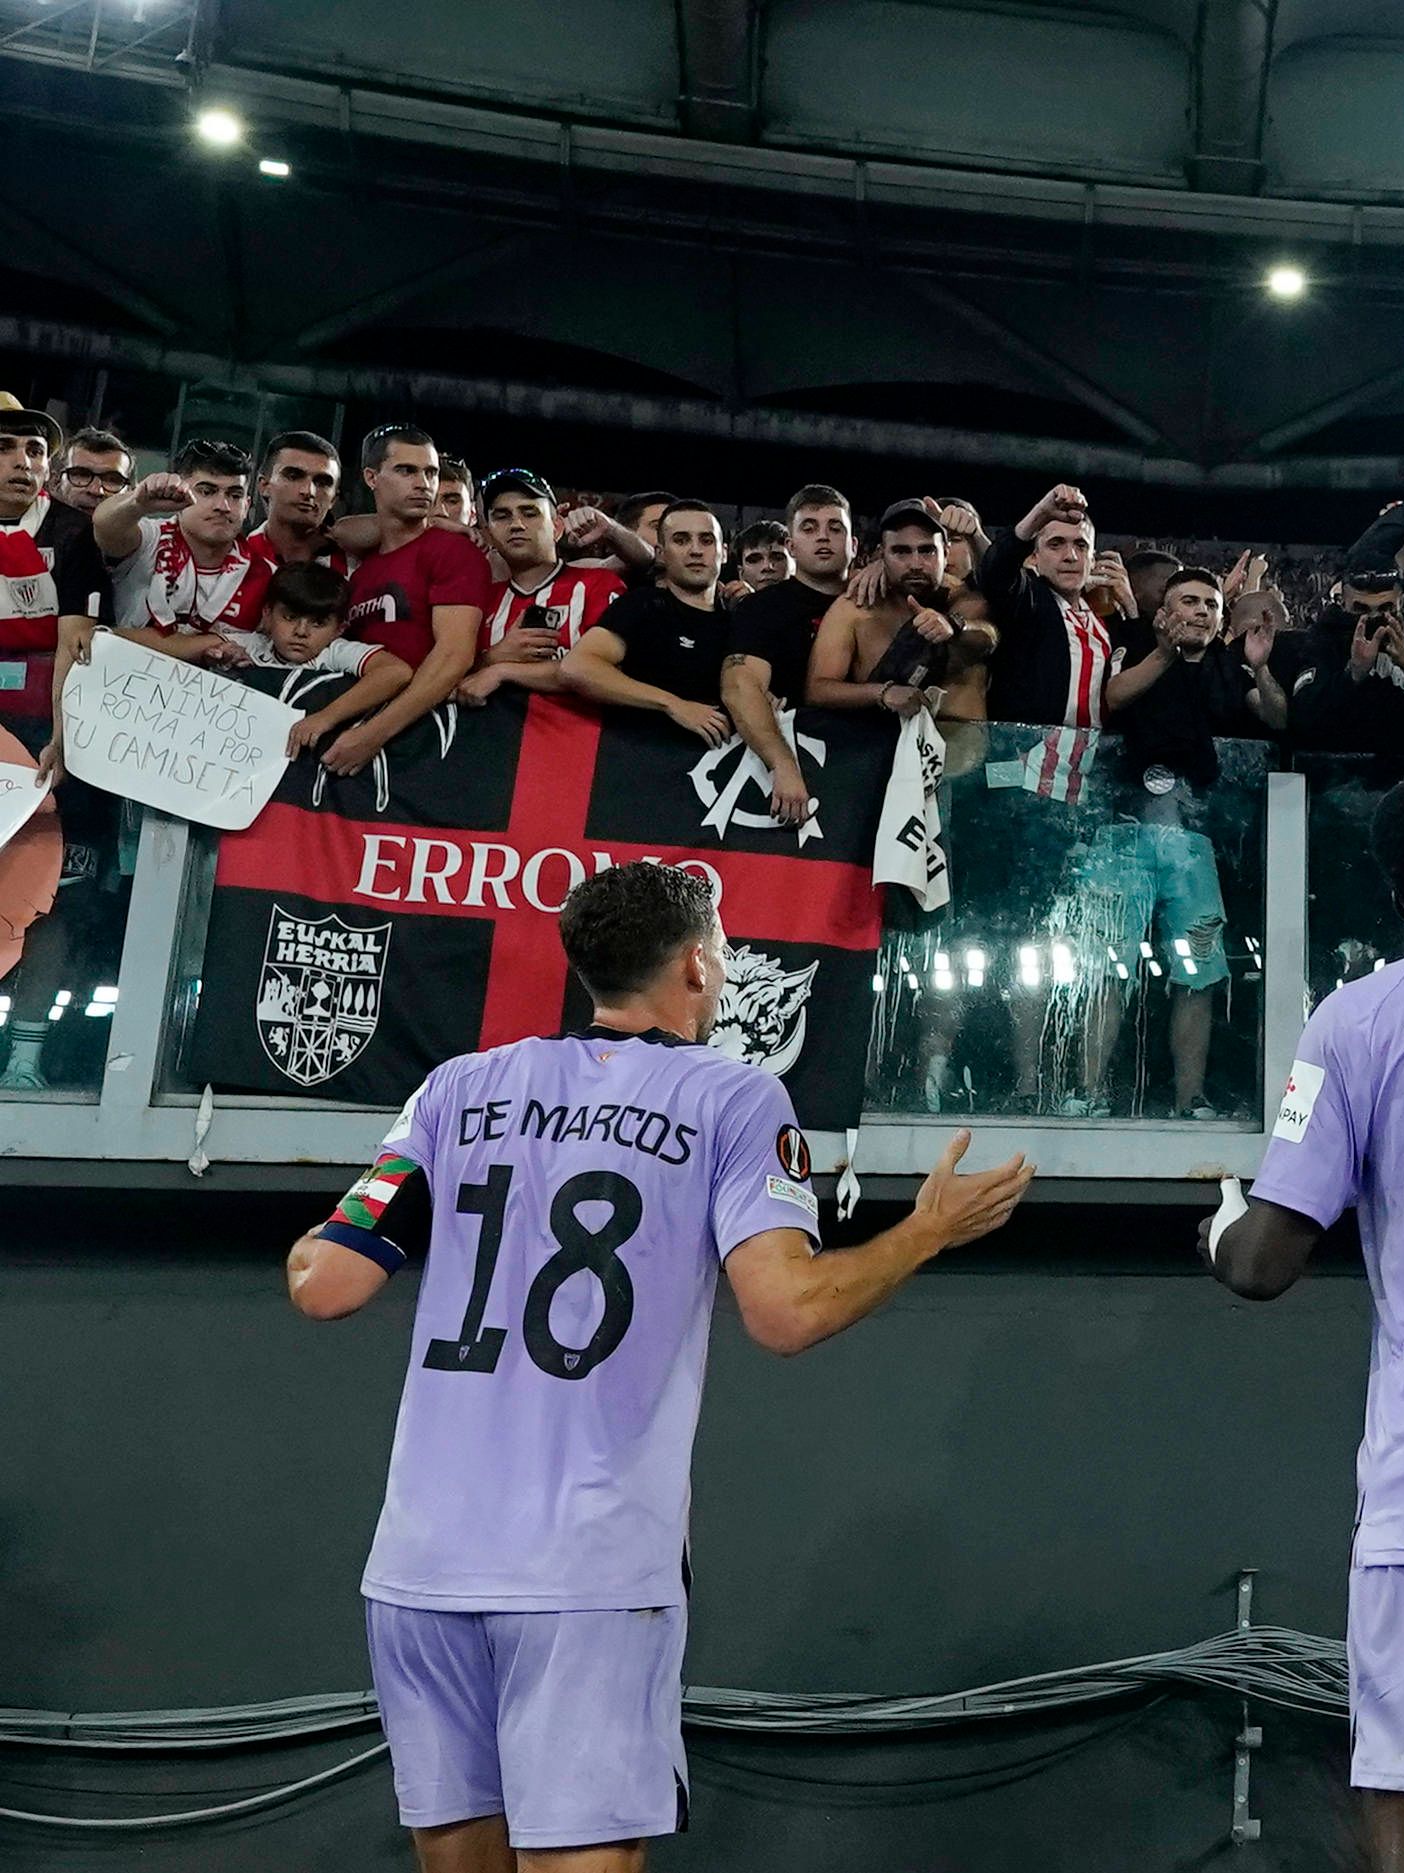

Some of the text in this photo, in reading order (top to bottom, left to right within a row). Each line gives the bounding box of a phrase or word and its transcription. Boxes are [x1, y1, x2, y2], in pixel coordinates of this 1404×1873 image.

[65, 684, 263, 766] A ROMA A POR
[103, 666, 256, 740] VENIMOS
[62, 711, 253, 804] TU CAMISETA
[353, 834, 723, 914] ERROO
[277, 921, 382, 953] EUSKAL
[459, 1099, 698, 1165] DE MARCOS
[1279, 1107, 1308, 1127] PAY
[422, 1164, 643, 1380] 18
